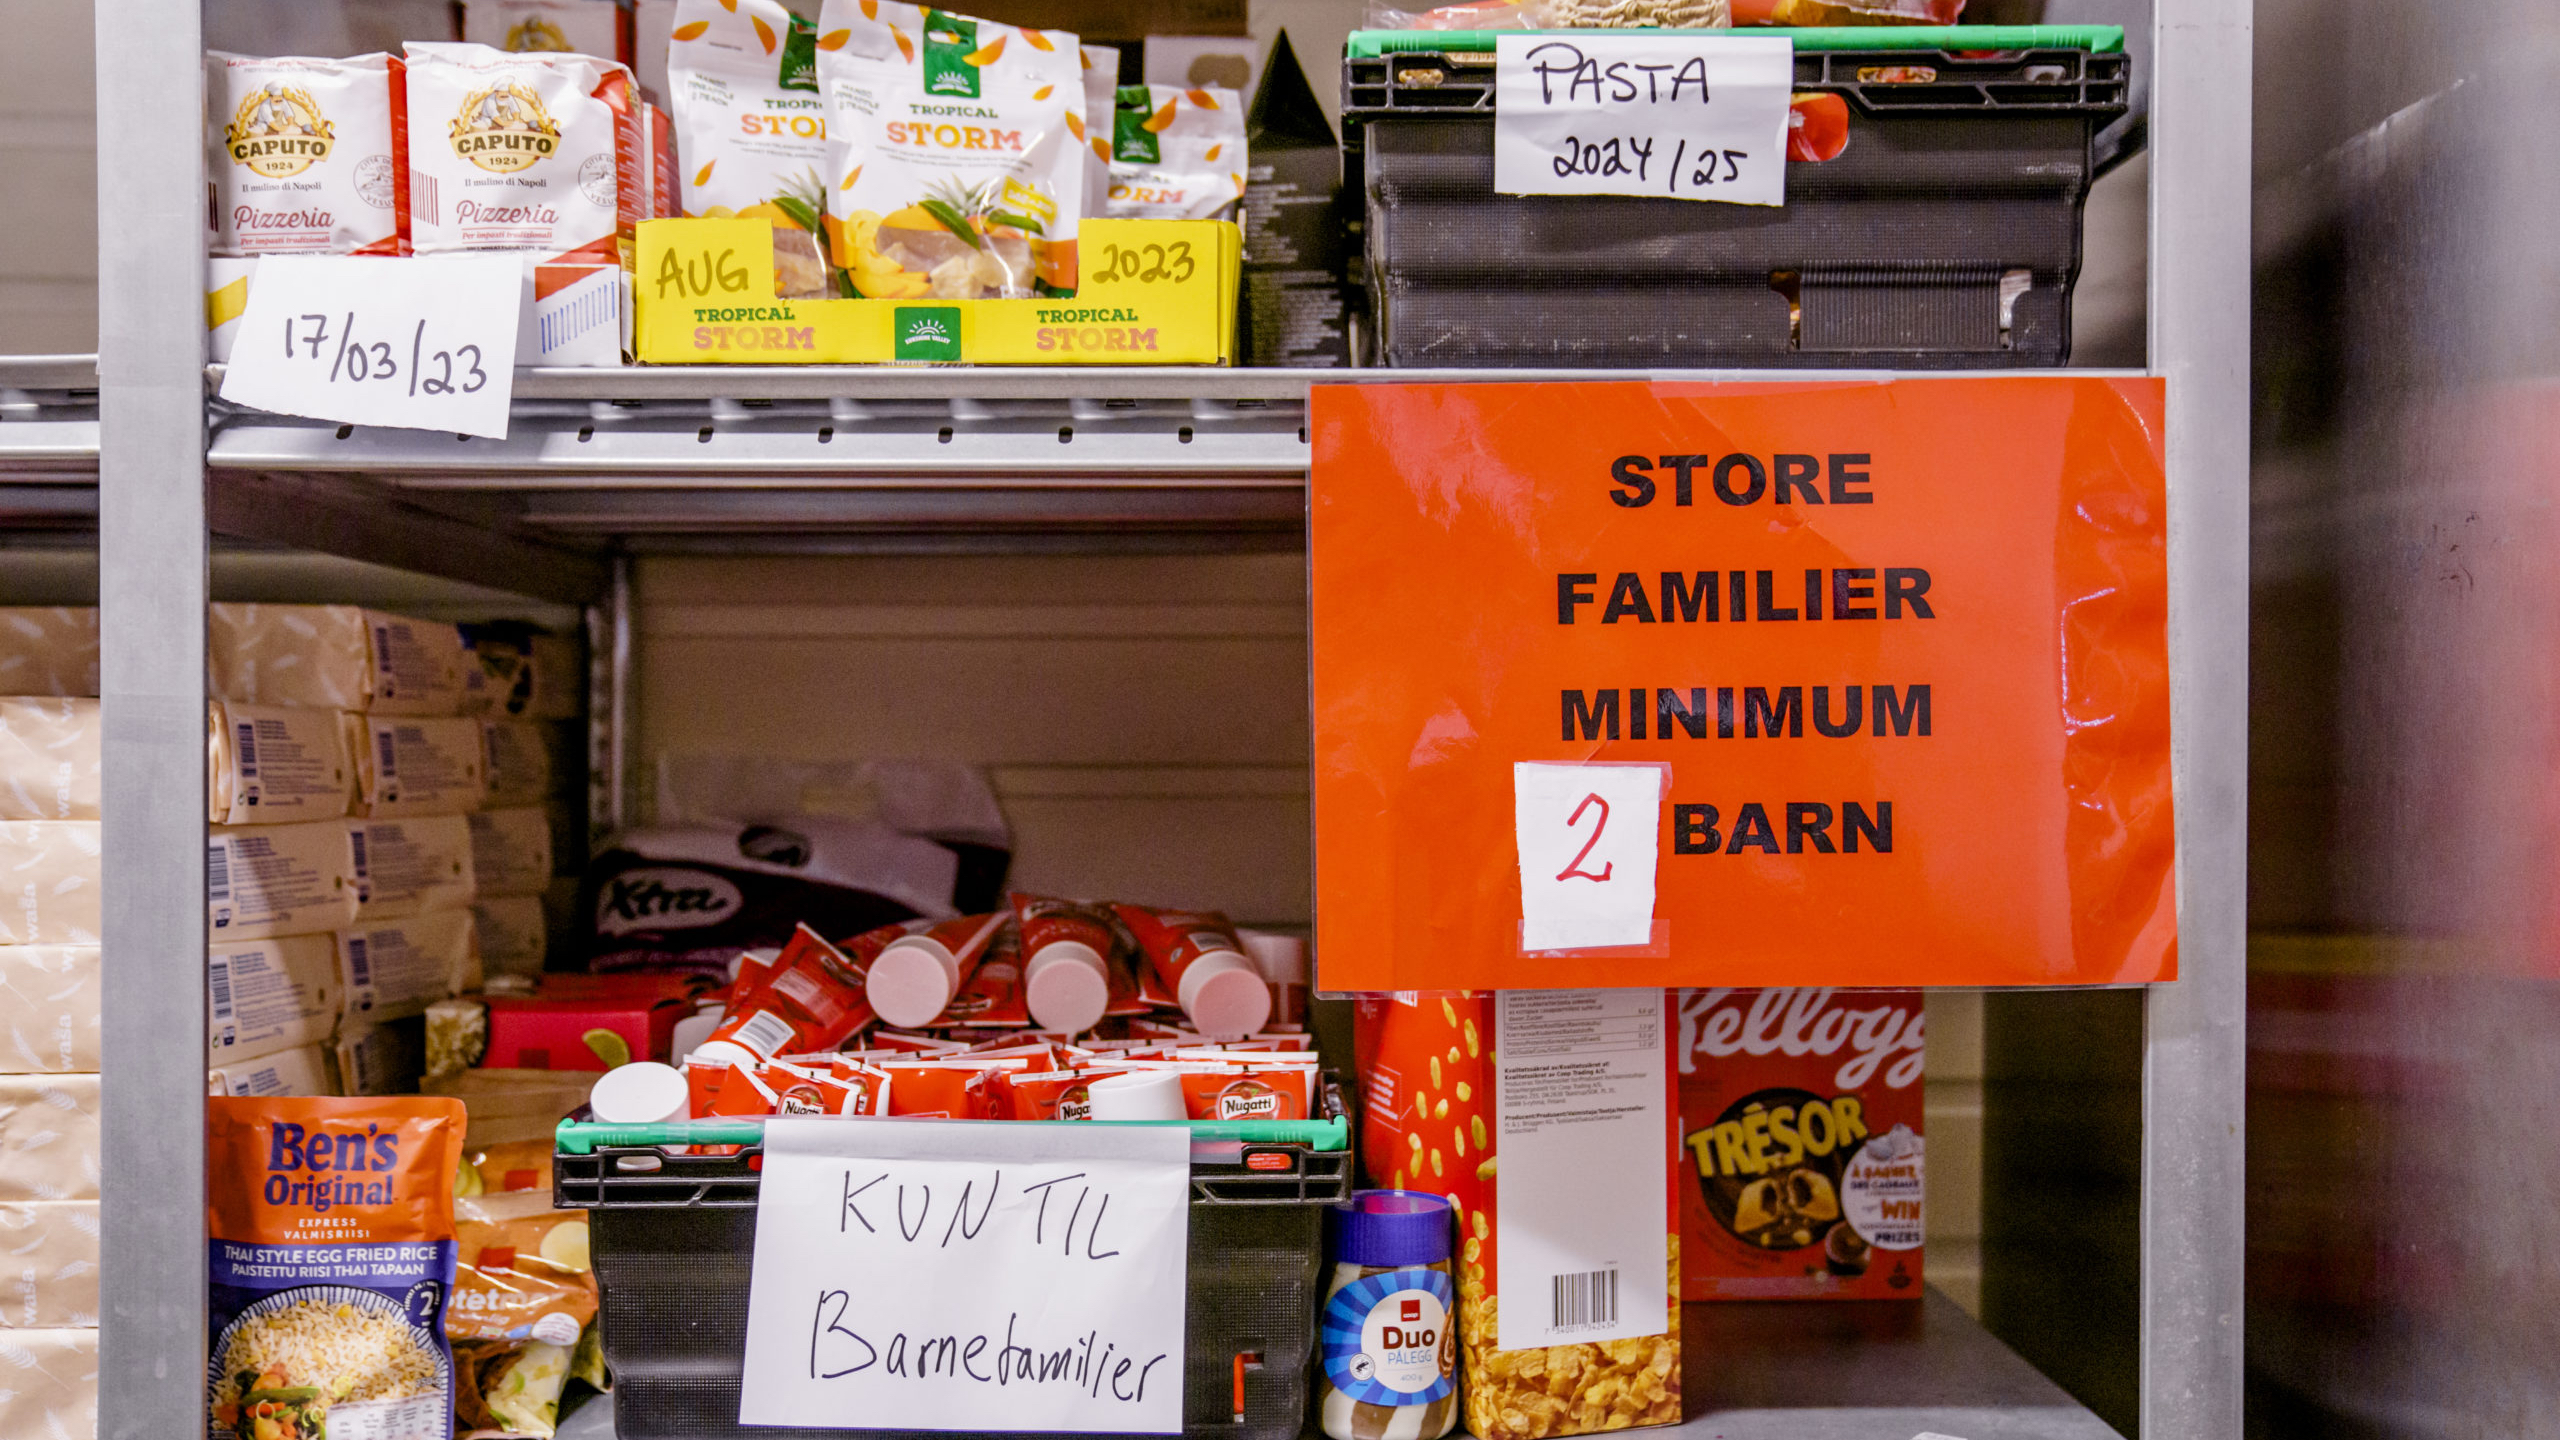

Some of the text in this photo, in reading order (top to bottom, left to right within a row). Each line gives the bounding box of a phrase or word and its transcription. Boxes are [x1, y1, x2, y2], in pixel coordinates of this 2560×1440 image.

[1526, 42, 1711, 105] PASTA
[909, 103, 998, 118] TROPICAL
[457, 134, 552, 154] CAPUTO
[886, 121, 1023, 151] STORM
[234, 140, 327, 160] CAPUTO
[489, 157, 518, 166] 1924
[266, 161, 293, 171] 1924
[242, 181, 322, 192] Il mulino di Napoli
[464, 177, 546, 188] Il mulino di Napoli
[234, 205, 335, 230] Pizzeria
[456, 200, 559, 224] Pizzeria
[656, 247, 749, 299] AUG
[1092, 241, 1195, 285] 2023
[694, 306, 795, 323] TROPICAL
[1037, 308, 1138, 323] TROPICAL
[693, 326, 816, 351] STORM
[1036, 327, 1160, 352] STORM
[285, 311, 488, 397] 17/03/23
[1609, 453, 1874, 508] STORE
[1557, 567, 1936, 625] FAMILIER
[1561, 684, 1932, 741] MINIMUM
[56, 761, 73, 819] wasa
[1555, 791, 1612, 883] 2
[1673, 801, 1893, 855] BARN
[24, 881, 39, 942] wasa
[59, 1014, 73, 1072] wasa
[1225, 1098, 1272, 1115] Nugatti
[268, 1122, 399, 1172] Ben's
[1686, 1097, 1868, 1178] TRÉSOR
[264, 1174, 394, 1213] Original
[841, 1169, 1119, 1260] KUN TIL
[1881, 1200, 1921, 1220] WIN
[284, 1229, 370, 1240] VALMISRIISI
[299, 1218, 357, 1228] EXPRESS
[1875, 1231, 1920, 1243] PRIZES
[225, 1245, 437, 1264] THAI STYLE EGG FRIED RICE
[231, 1262, 425, 1278] PAISTETTU RIISI THAI TAPAAN
[23, 1268, 37, 1327] wasa
[419, 1291, 434, 1317] 2
[810, 1289, 1167, 1402] Barnefamilier
[1383, 1326, 1436, 1350] Duo
[1388, 1349, 1432, 1365] PÅLEGG
